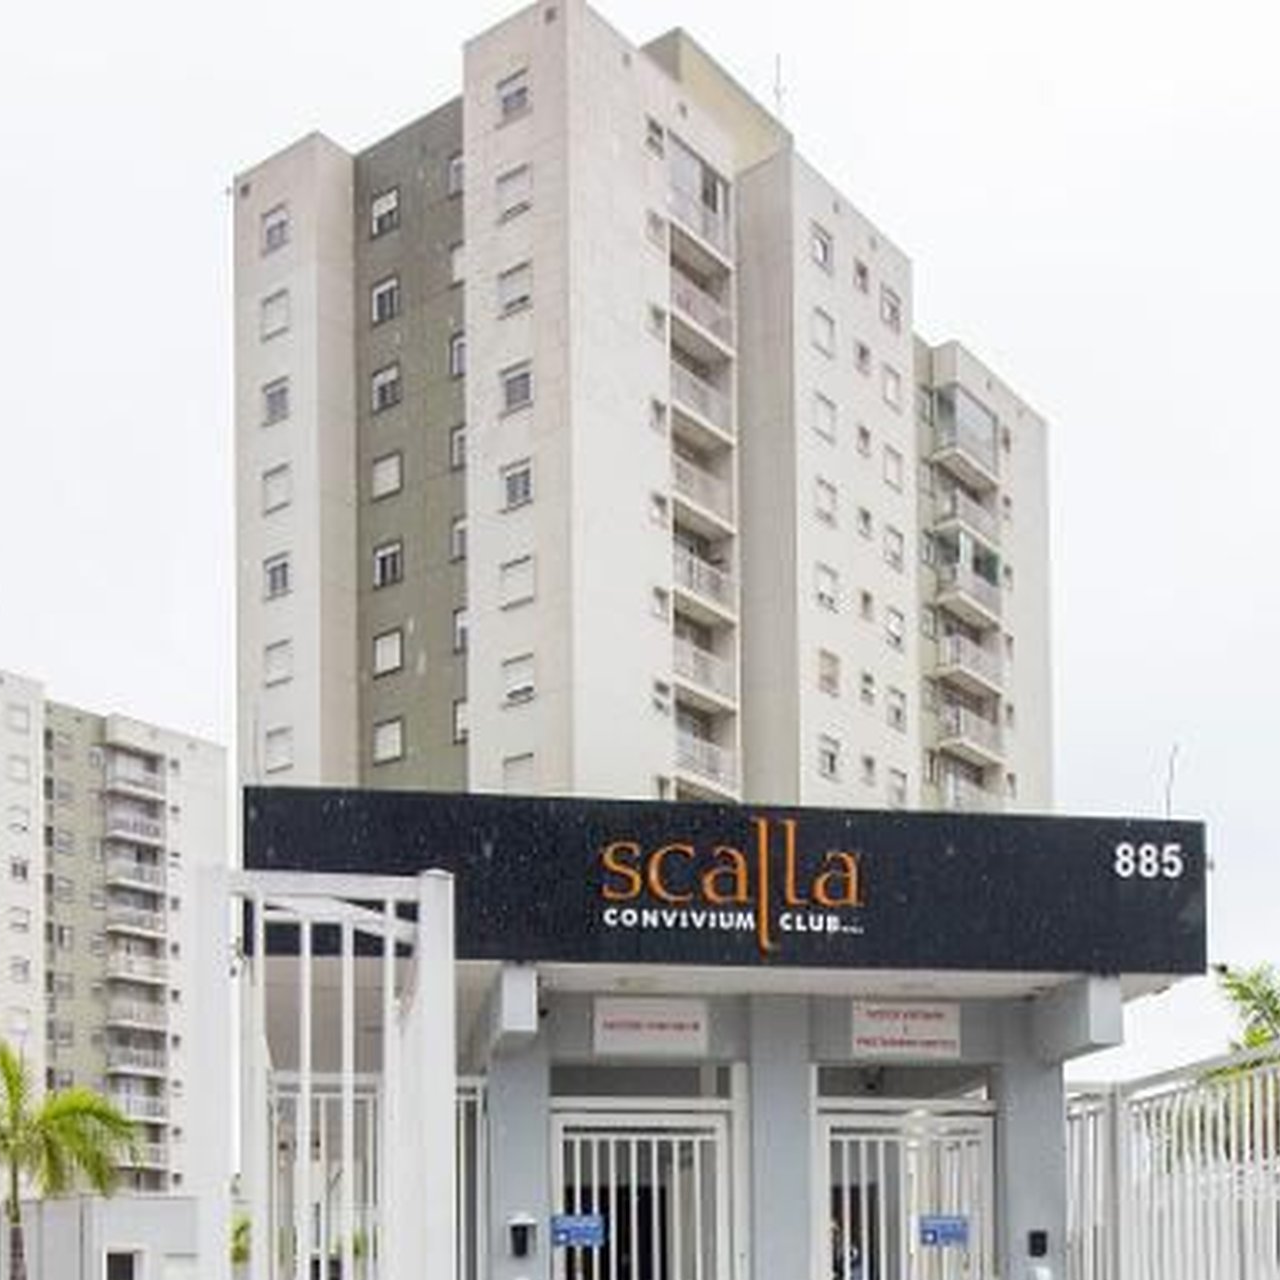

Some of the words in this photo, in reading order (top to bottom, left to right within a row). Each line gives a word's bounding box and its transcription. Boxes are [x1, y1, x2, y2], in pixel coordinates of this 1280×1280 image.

[1115, 842, 1183, 878] 885
[601, 816, 864, 952] scalla
[603, 909, 756, 930] CONVIVIUM
[779, 912, 840, 931] CLUB
